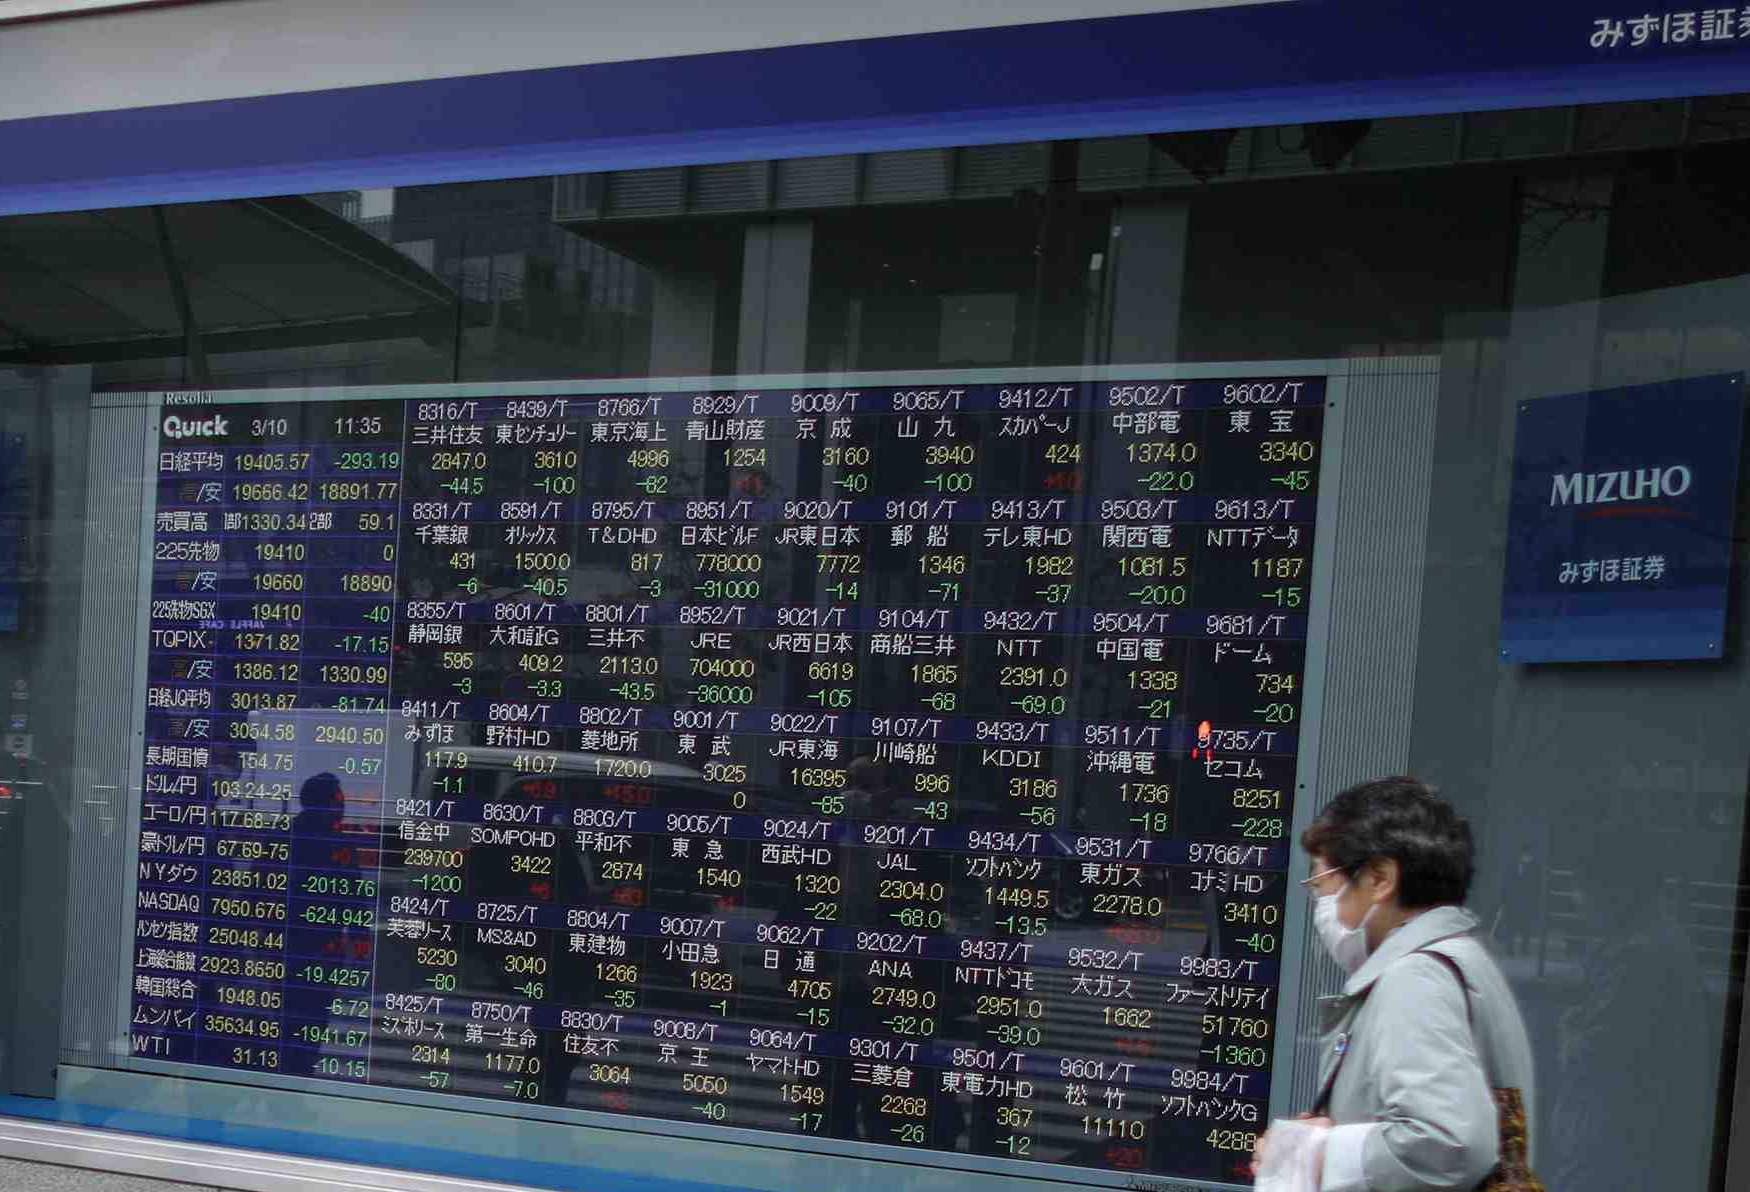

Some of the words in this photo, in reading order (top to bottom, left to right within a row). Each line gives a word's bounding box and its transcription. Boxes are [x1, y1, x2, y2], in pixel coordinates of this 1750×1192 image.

[790, 392, 860, 412] 9009/T
[998, 386, 1073, 408] 9412/T
[1222, 381, 1304, 404] 9602/T
[418, 401, 478, 421] 8316/T
[597, 396, 662, 416] 8766/T
[163, 414, 229, 439] Quick
[251, 418, 287, 436] 3/10
[334, 416, 381, 434] 11:35
[590, 420, 666, 443] 東京海上
[685, 416, 765, 441] 青山財産
[1112, 410, 1181, 434] 中部電
[411, 424, 483, 446] 三井住友
[160, 450, 224, 472] 日経平均
[234, 453, 310, 471] 19405.57
[333, 451, 400, 469] -293.19
[534, 450, 577, 469] 3610
[925, 445, 974, 465] 3940
[233, 483, 308, 501] 19666.42
[319, 483, 398, 500] 18891.77
[1550, 464, 1691, 508] MIZUHO
[500, 500, 563, 520] 8591/T
[686, 499, 753, 519] 8951/T
[885, 498, 957, 519] 9101/T
[1100, 498, 1178, 519] 9503/T
[157, 511, 208, 532] 売買高
[358, 513, 393, 531] 59.1
[414, 526, 469, 547] 千葉銀
[774, 524, 860, 546] JR東日本
[983, 525, 1072, 547] テレ東HD
[1102, 524, 1173, 548] 関西電
[155, 540, 220, 561] 225先物
[254, 544, 304, 561] 19410
[383, 544, 394, 561] 0
[449, 551, 475, 569] 431
[816, 554, 861, 573] 7772
[1251, 558, 1304, 578] 1187
[1558, 555, 1666, 584] みずほ証券
[253, 574, 303, 591] 19660
[340, 574, 392, 592] 18890
[251, 603, 301, 621] 19410
[362, 606, 390, 623] -40
[407, 600, 466, 619] 8355/T
[585, 603, 650, 623] 8801/T
[777, 606, 846, 627] 9021/T
[983, 609, 1057, 631] 9432/T
[489, 625, 559, 646] 大和証G
[1206, 614, 1286, 636] 9681/T
[151, 629, 207, 649] TOPIX
[235, 633, 300, 651] 1371.82
[334, 635, 389, 653] -17.15
[587, 628, 645, 649] 三井不
[690, 632, 732, 649] JRE
[768, 632, 853, 654] JR西日本
[870, 633, 956, 656] 商船三井
[997, 639, 1042, 656] NTT
[1096, 638, 1164, 661] 中国電
[233, 663, 298, 681] 1386.12
[319, 665, 387, 684] 1330.99
[689, 658, 754, 678] 704000
[1127, 670, 1178, 690] 1338
[148, 687, 211, 709] 日経JQ平均
[230, 692, 299, 711] 3013.87
[331, 696, 386, 714] -81.74
[489, 703, 551, 722] 8604/T
[673, 710, 738, 730] 9001/T
[229, 721, 295, 741] 3054.58
[315, 725, 384, 744] 2940.50
[486, 727, 549, 748] 野村HD
[871, 717, 942, 738] 9107/T
[1084, 724, 1161, 747] 9511/T
[145, 745, 209, 768] 長期国債
[237, 751, 293, 771] 154.75
[338, 757, 382, 775] -0.57
[768, 739, 839, 761] JR東海
[982, 749, 1040, 768] KDDI
[1086, 750, 1156, 774] 沖縄電
[396, 797, 456, 818] 8421/T
[1233, 788, 1280, 809] 8251
[573, 808, 637, 829] 8803/T
[763, 818, 832, 840] 9024/T
[399, 823, 450, 843] 信金中
[470, 827, 556, 848] SOMPOHD
[574, 832, 632, 853] 平和不
[968, 830, 1041, 853] 9434/T
[217, 839, 289, 861] 67.69-75
[761, 843, 831, 865] 西武HD
[1188, 842, 1268, 866] 9766/T
[876, 853, 917, 871] JAL
[211, 868, 287, 891] 23851.02
[301, 876, 375, 897] -2013.76
[697, 867, 741, 887] 1540
[138, 891, 200, 913] NASDAQ
[211, 897, 286, 920] 7950.676
[300, 907, 373, 928] -624.942
[476, 902, 538, 924] 8725/T
[1093, 894, 1162, 918] 2278.0
[477, 927, 537, 947] MS&AD
[659, 916, 726, 938] 9007/T
[208, 927, 283, 950] 25048.44
[567, 933, 626, 956] 東建物
[856, 931, 927, 954] 9202/T
[661, 940, 720, 964] 小田急
[1068, 947, 1144, 971] 9532/T
[199, 955, 285, 979] 2923.8650
[296, 967, 370, 987] -19.4257
[596, 962, 637, 983] 1266
[867, 959, 913, 979] ANA
[134, 975, 198, 1000] 韓国総合
[217, 986, 281, 1009] 1948.05
[385, 992, 444, 1014] 8425/T
[976, 995, 1042, 1018] 2951.0
[132, 1004, 197, 1030] ムンバイ
[204, 1014, 282, 1038] 35634.95
[294, 1026, 367, 1047] -1941.67
[560, 1010, 624, 1032] 8830/T
[464, 1024, 538, 1048] 第一生命
[562, 1033, 620, 1057] 住友不
[749, 1028, 817, 1051] 9064/T
[132, 1034, 170, 1055] WTI
[233, 1047, 278, 1067] 31.13
[313, 1059, 365, 1078] -10.15
[485, 1053, 540, 1074] 1177.0
[952, 1047, 1025, 1072] 9501/T
[850, 1062, 914, 1088] 三菱倉
[940, 1071, 1034, 1098] 東電力HD
[1170, 1068, 1249, 1094] 9984/T
